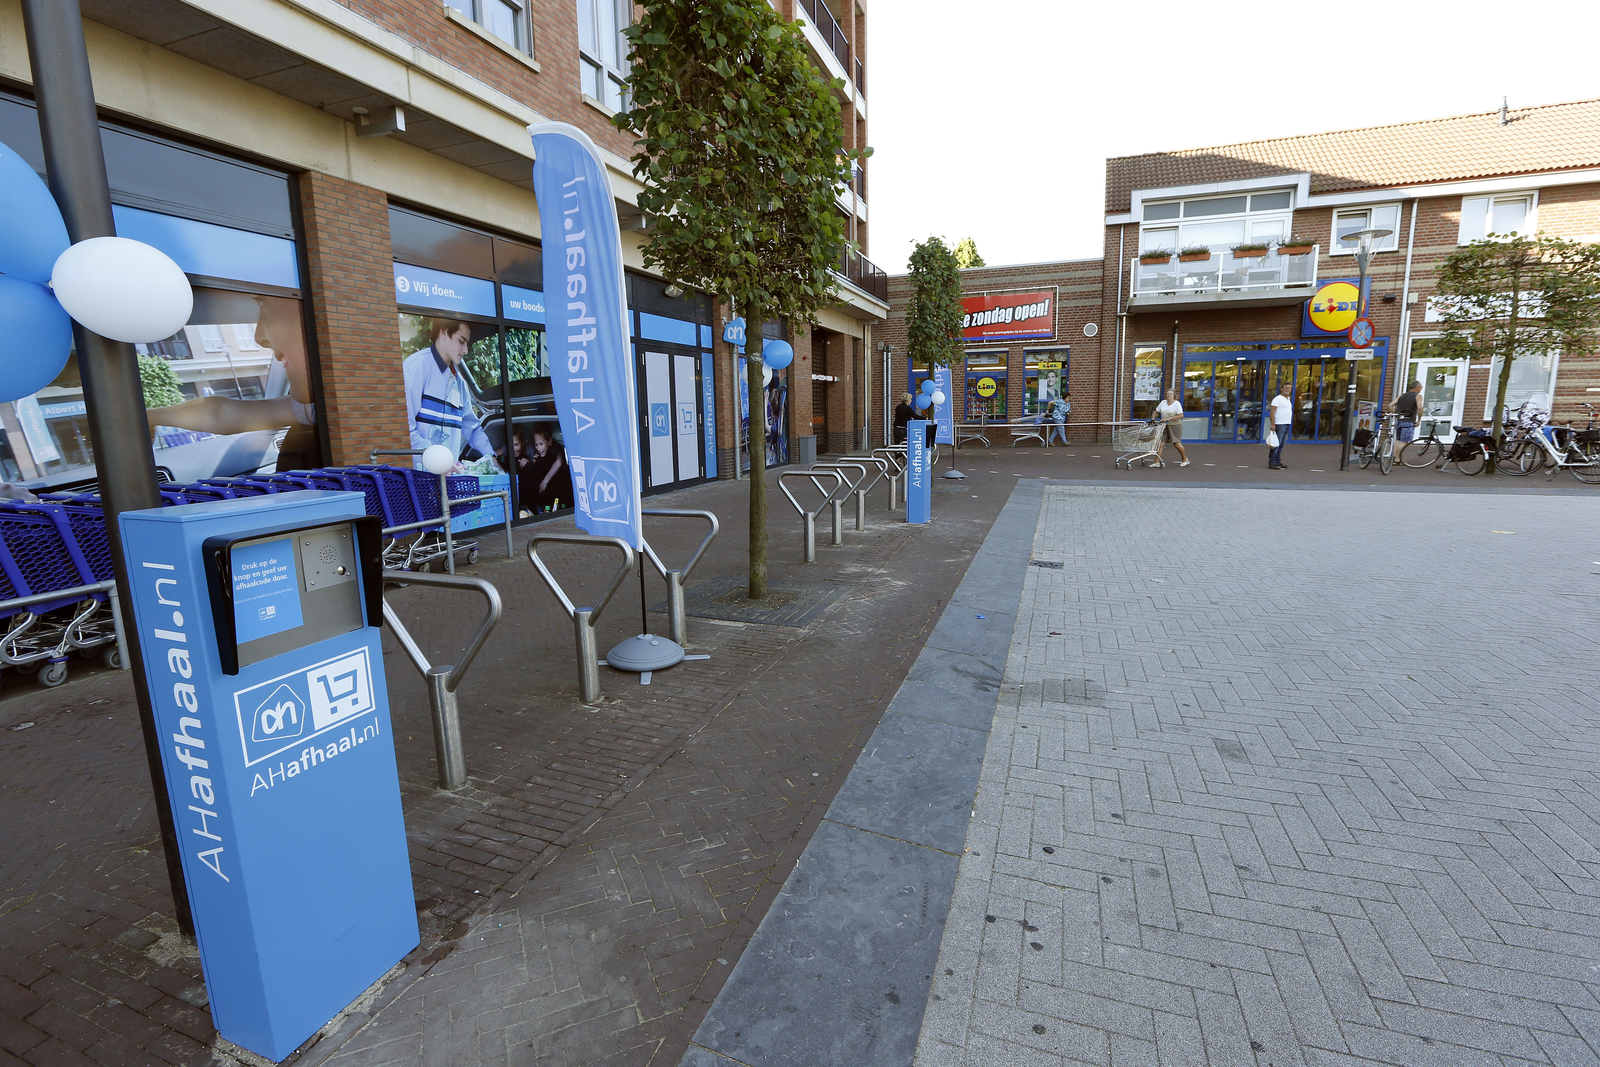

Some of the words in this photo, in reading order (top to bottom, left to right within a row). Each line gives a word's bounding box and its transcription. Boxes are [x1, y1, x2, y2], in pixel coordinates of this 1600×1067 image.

[412, 280, 430, 297] Wij
[432, 284, 463, 300] doen...
[510, 300, 522, 309] uw
[971, 307, 1014, 324] zondag
[1014, 299, 1050, 321] open!
[45, 405, 76, 416] Albert
[704, 376, 715, 455] AHafhaal.nl
[912, 428, 923, 488] AHafhaal.nl
[233, 573, 251, 582] knop
[261, 566, 276, 577] geef
[241, 562, 258, 571] Druk
[235, 577, 271, 590] afhaalcode
[272, 574, 288, 582] door.
[142, 561, 231, 884] AHafhaal.nl
[250, 716, 380, 798] AHafhaal.nl
